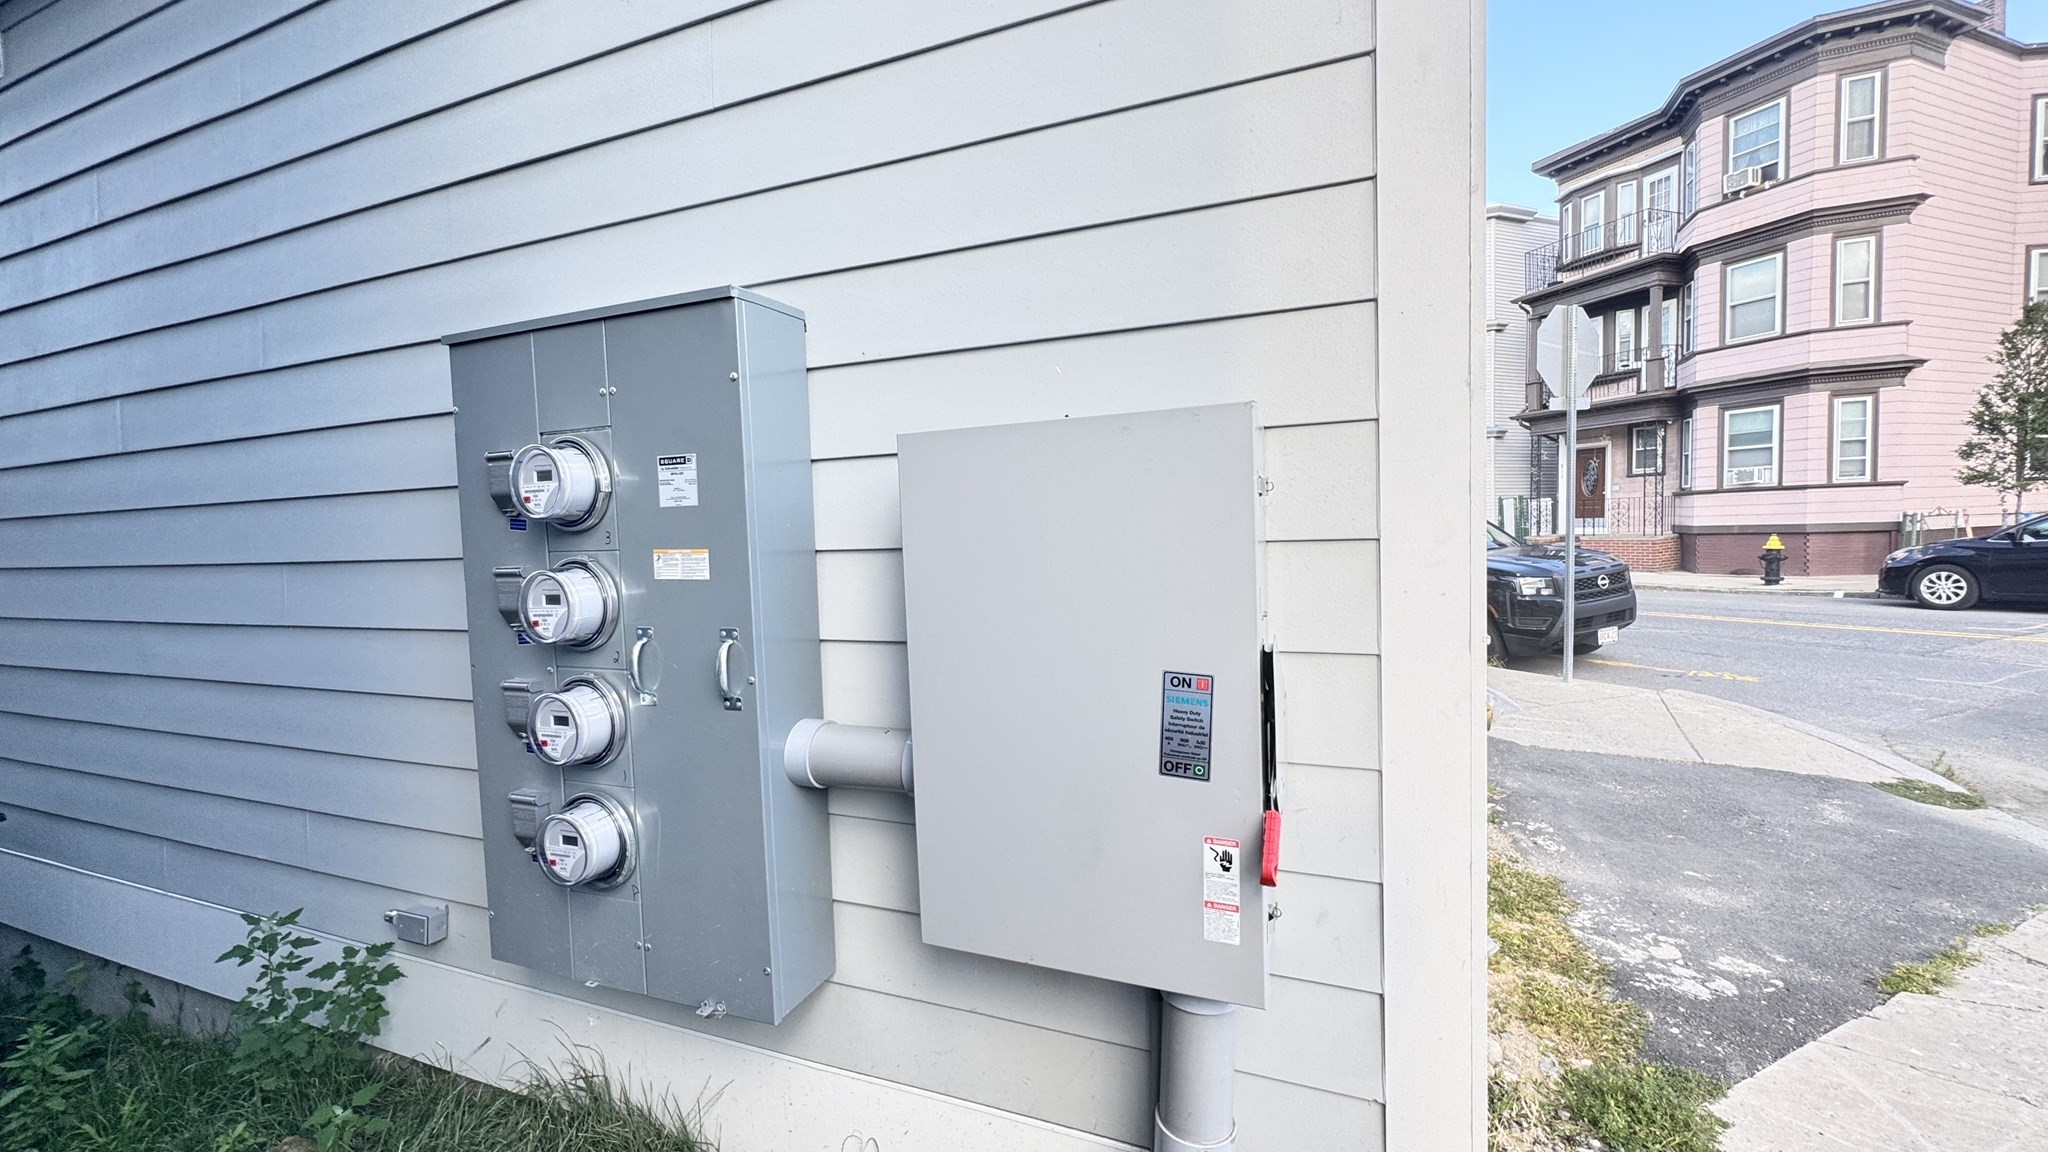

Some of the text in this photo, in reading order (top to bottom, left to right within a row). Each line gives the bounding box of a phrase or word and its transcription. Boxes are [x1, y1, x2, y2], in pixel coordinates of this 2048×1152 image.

[660, 457, 685, 465] SQUARE
[605, 530, 611, 545] 3
[1170, 676, 1192, 689] ON
[1166, 695, 1209, 707] SIEMENS
[1172, 708, 1188, 716] Heavy
[1163, 760, 1192, 774] OFF
[1213, 838, 1237, 847] DANGER
[1213, 902, 1237, 911] DANGER
